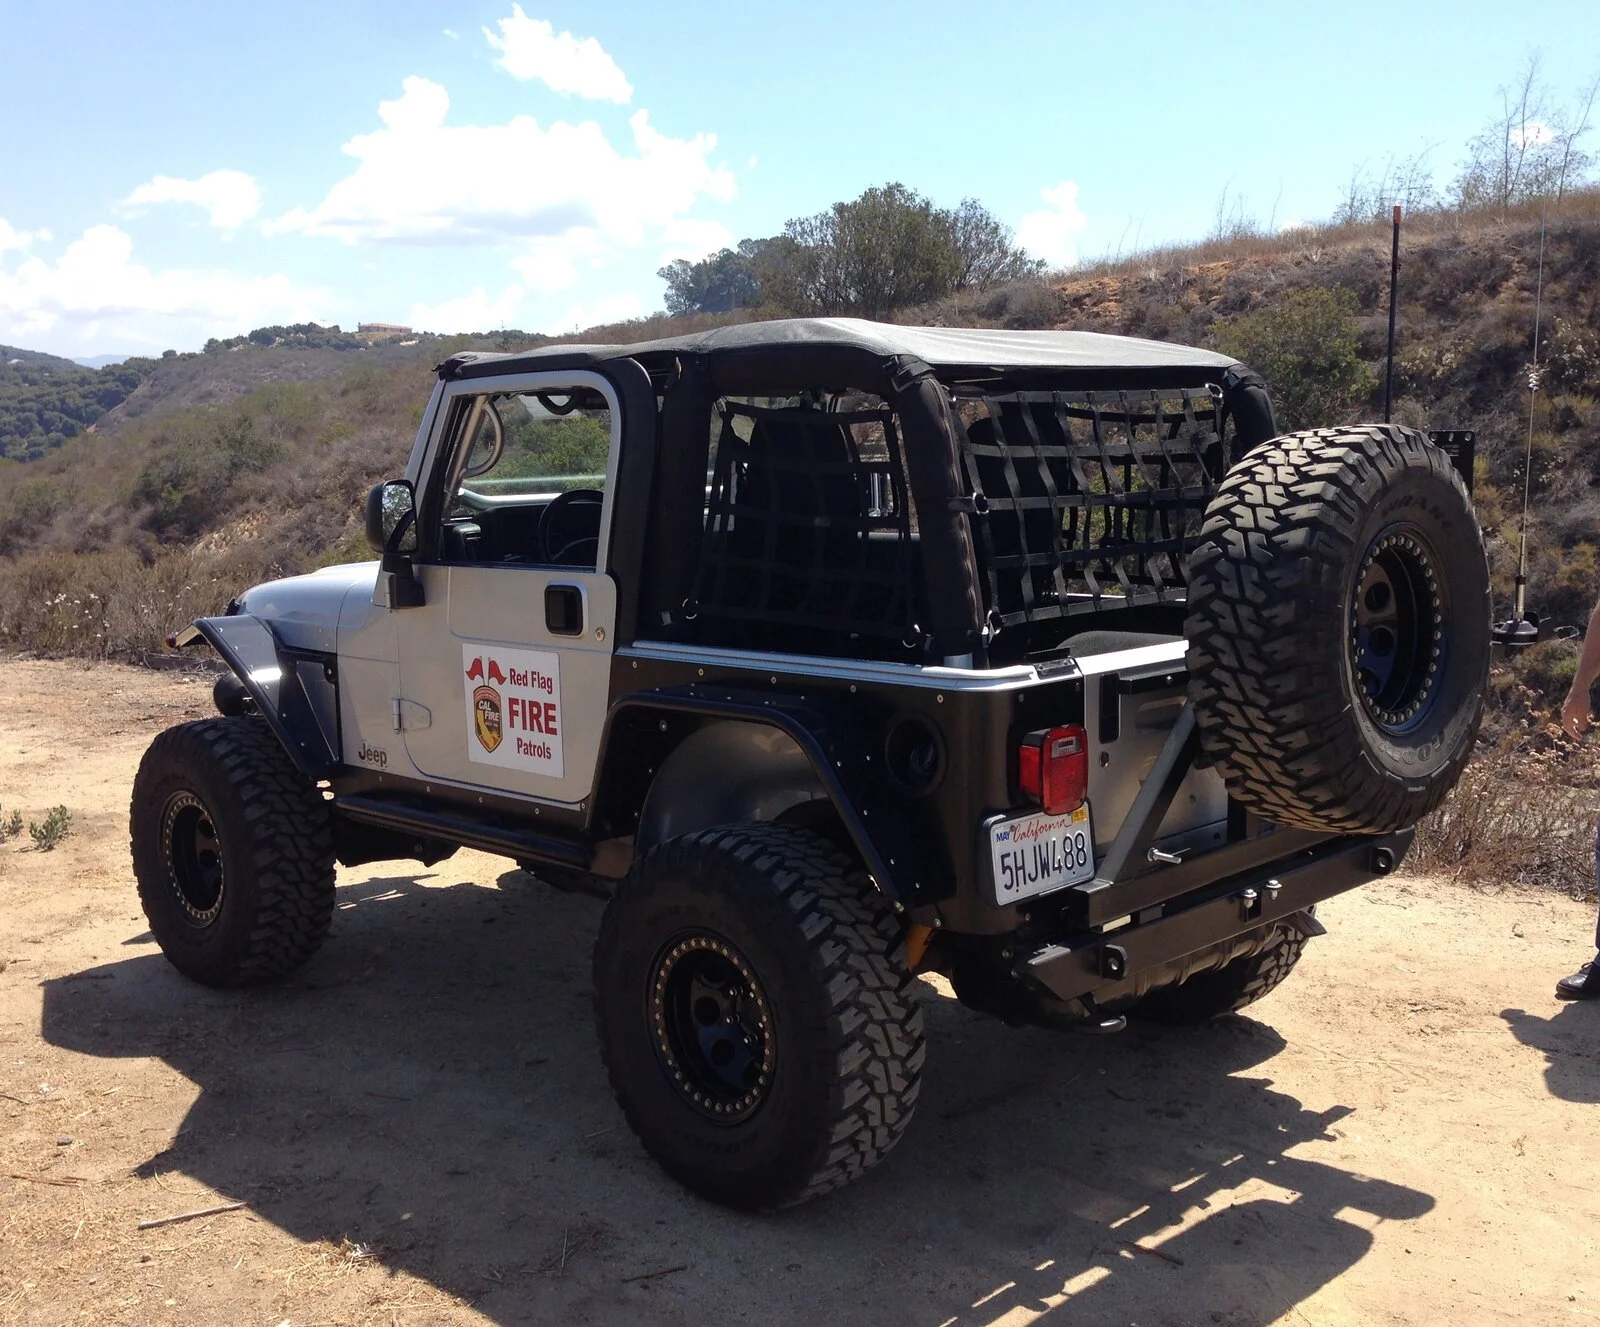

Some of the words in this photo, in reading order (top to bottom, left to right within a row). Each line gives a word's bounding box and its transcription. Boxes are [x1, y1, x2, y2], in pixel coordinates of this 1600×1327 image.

[509, 668, 529, 688] Red
[531, 670, 553, 695] Flag
[478, 700, 492, 711] CAL
[485, 710, 500, 722] FIRE
[508, 697, 558, 736] FIRE
[358, 742, 388, 767] Jeep
[516, 737, 552, 760] Patrols
[996, 831, 1010, 843] MAY
[1012, 817, 1072, 843] California
[1000, 831, 1087, 891] 5HJW488
